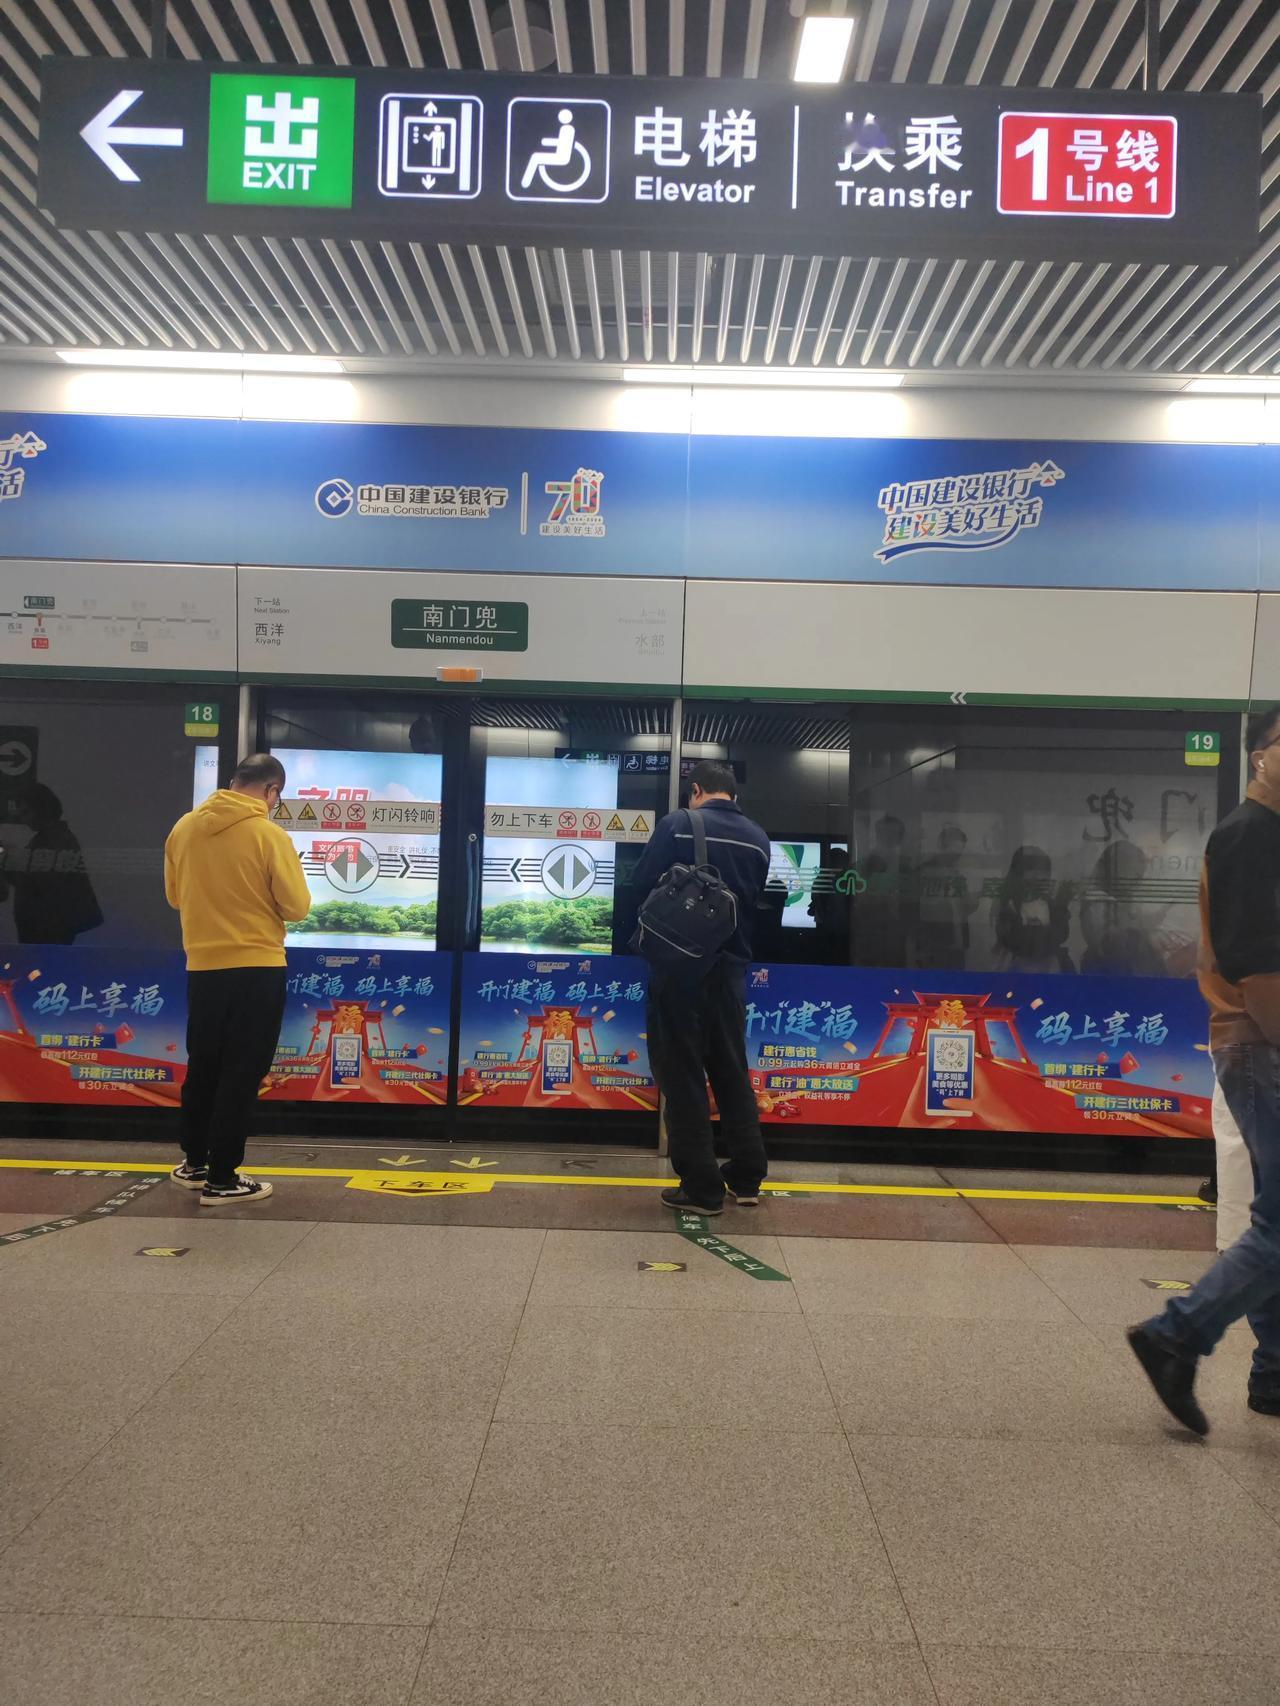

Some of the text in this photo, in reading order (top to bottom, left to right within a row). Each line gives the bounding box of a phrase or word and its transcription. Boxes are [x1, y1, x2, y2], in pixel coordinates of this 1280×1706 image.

[633, 106, 757, 168] 电梯
[242, 162, 317, 190] EXIT
[1015, 127, 1160, 201] 1 号线
[634, 176, 756, 203] Elevator
[836, 181, 973, 209] Transfer
[1066, 175, 1158, 203] Line 1
[359, 485, 508, 506] 中国建设银行
[546, 473, 601, 521] 70
[881, 468, 1036, 512] 中国建设银行
[359, 504, 488, 517] China Construction Bank
[885, 500, 1041, 542] 建设美好生活
[542, 524, 604, 536] 建设美好生活
[423, 603, 498, 629] 南门兜
[255, 622, 285, 637] 西洋
[426, 632, 494, 646] Nanmendou
[255, 638, 281, 647] Xiyang
[191, 706, 213, 721] 18
[1191, 734, 1214, 750] 19
[372, 807, 436, 824] 灯闪铃响
[491, 811, 553, 829] 勿上下车
[355, 975, 434, 998] 码上享福
[565, 981, 645, 1003] 码上享福
[33, 982, 165, 1018] 码上享福
[1035, 1009, 1169, 1048] 码上享福
[373, 1179, 470, 1190] 下车区
[697, 1237, 766, 1272] 先下后上
